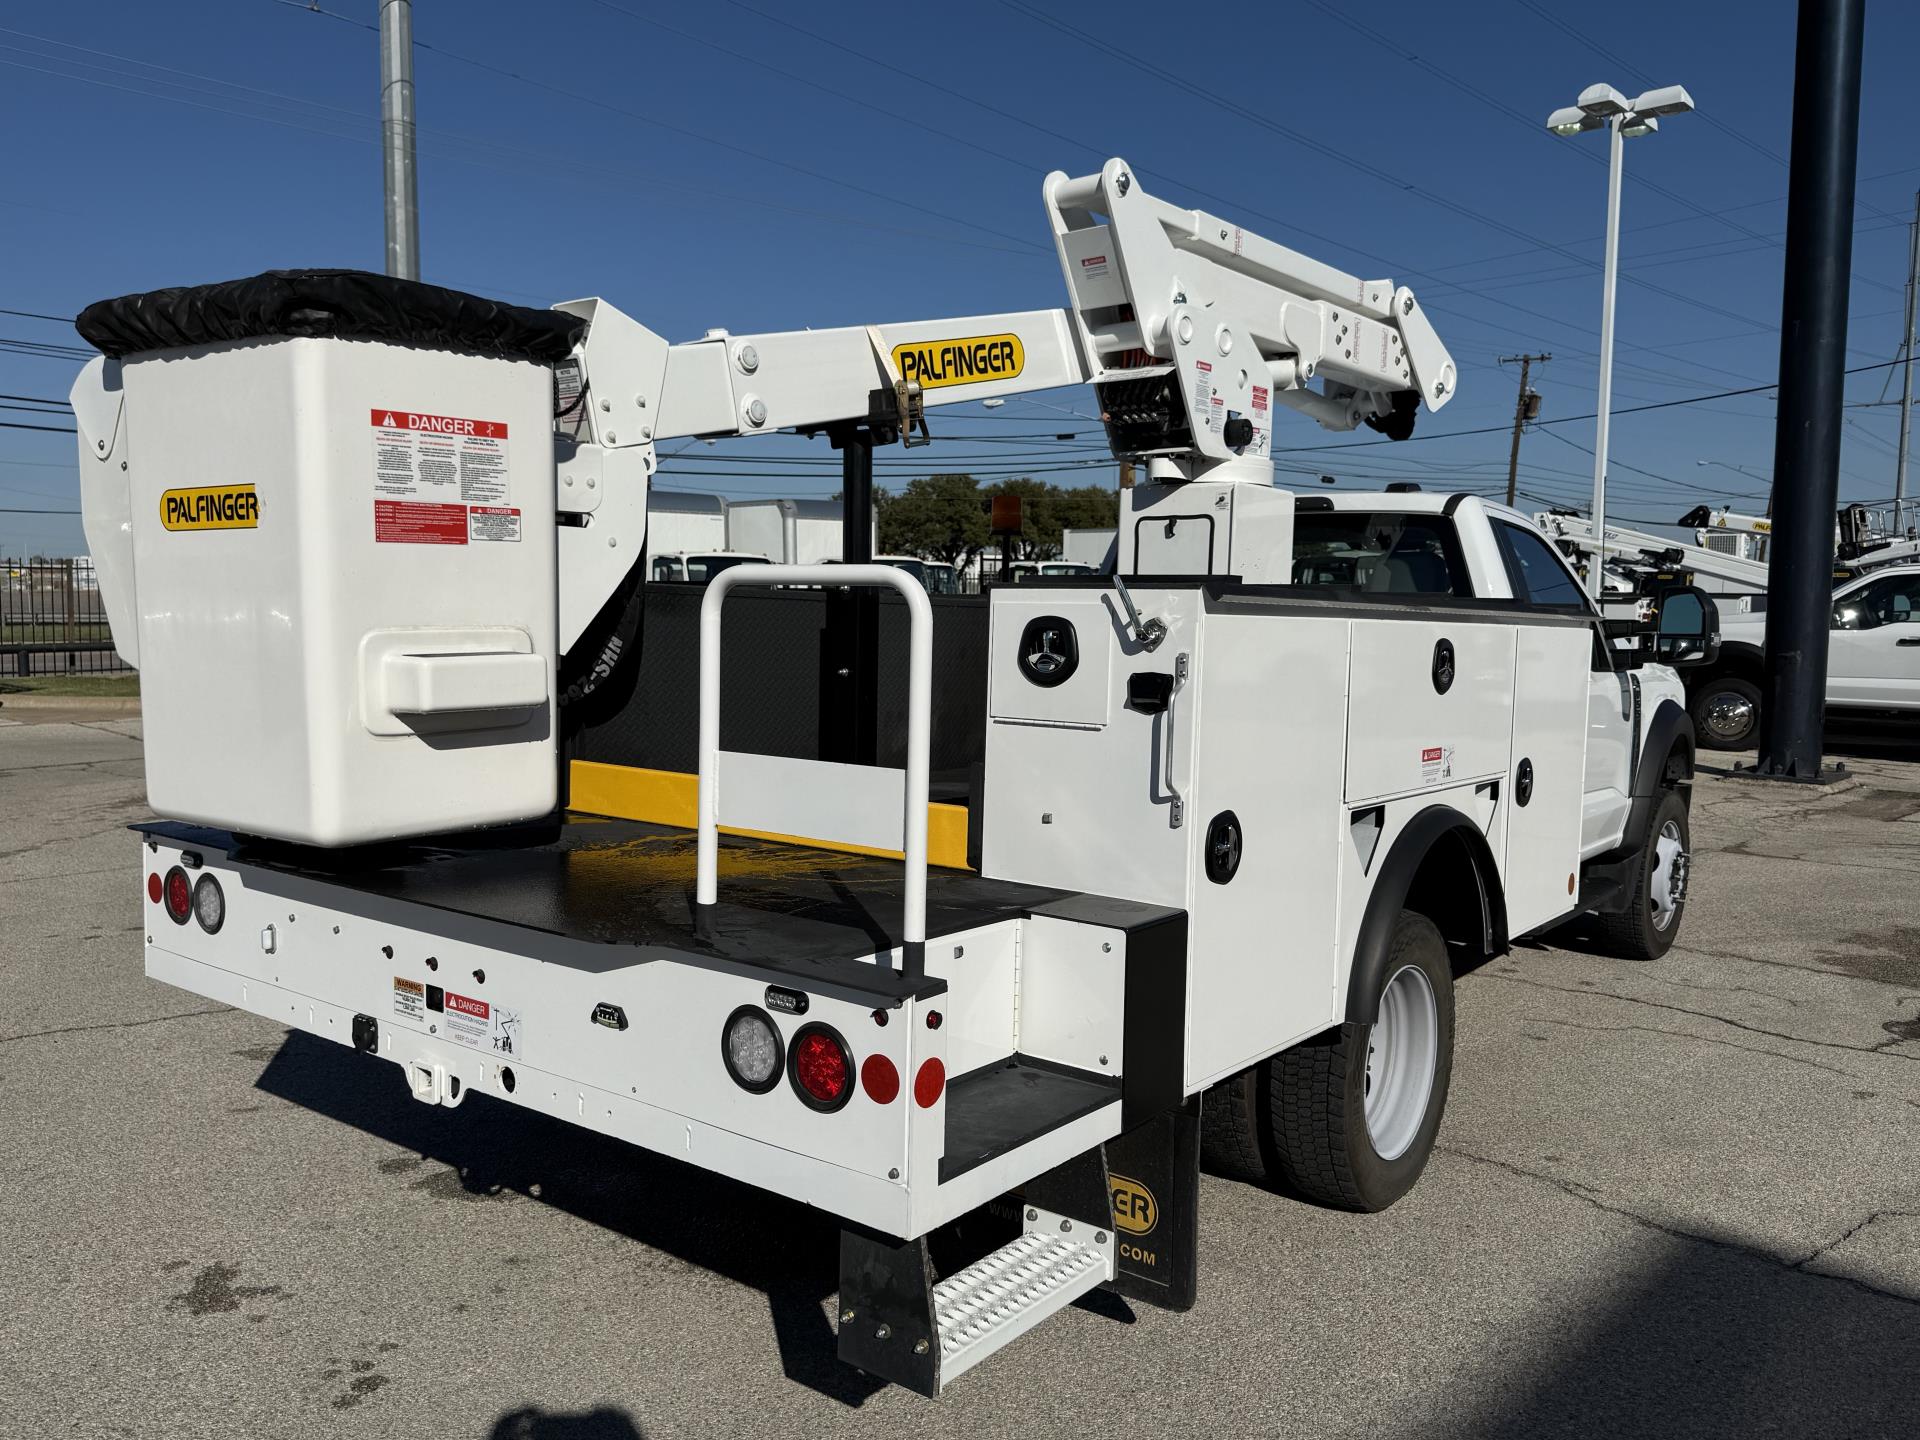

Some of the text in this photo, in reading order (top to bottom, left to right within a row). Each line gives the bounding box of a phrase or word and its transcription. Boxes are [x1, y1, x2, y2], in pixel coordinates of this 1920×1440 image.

[900, 341, 1016, 381] PALFINGER
[408, 414, 475, 435] DANGER
[166, 492, 259, 523] PALFINGER
[396, 978, 422, 992] WARNING
[458, 999, 485, 1015] DANGER
